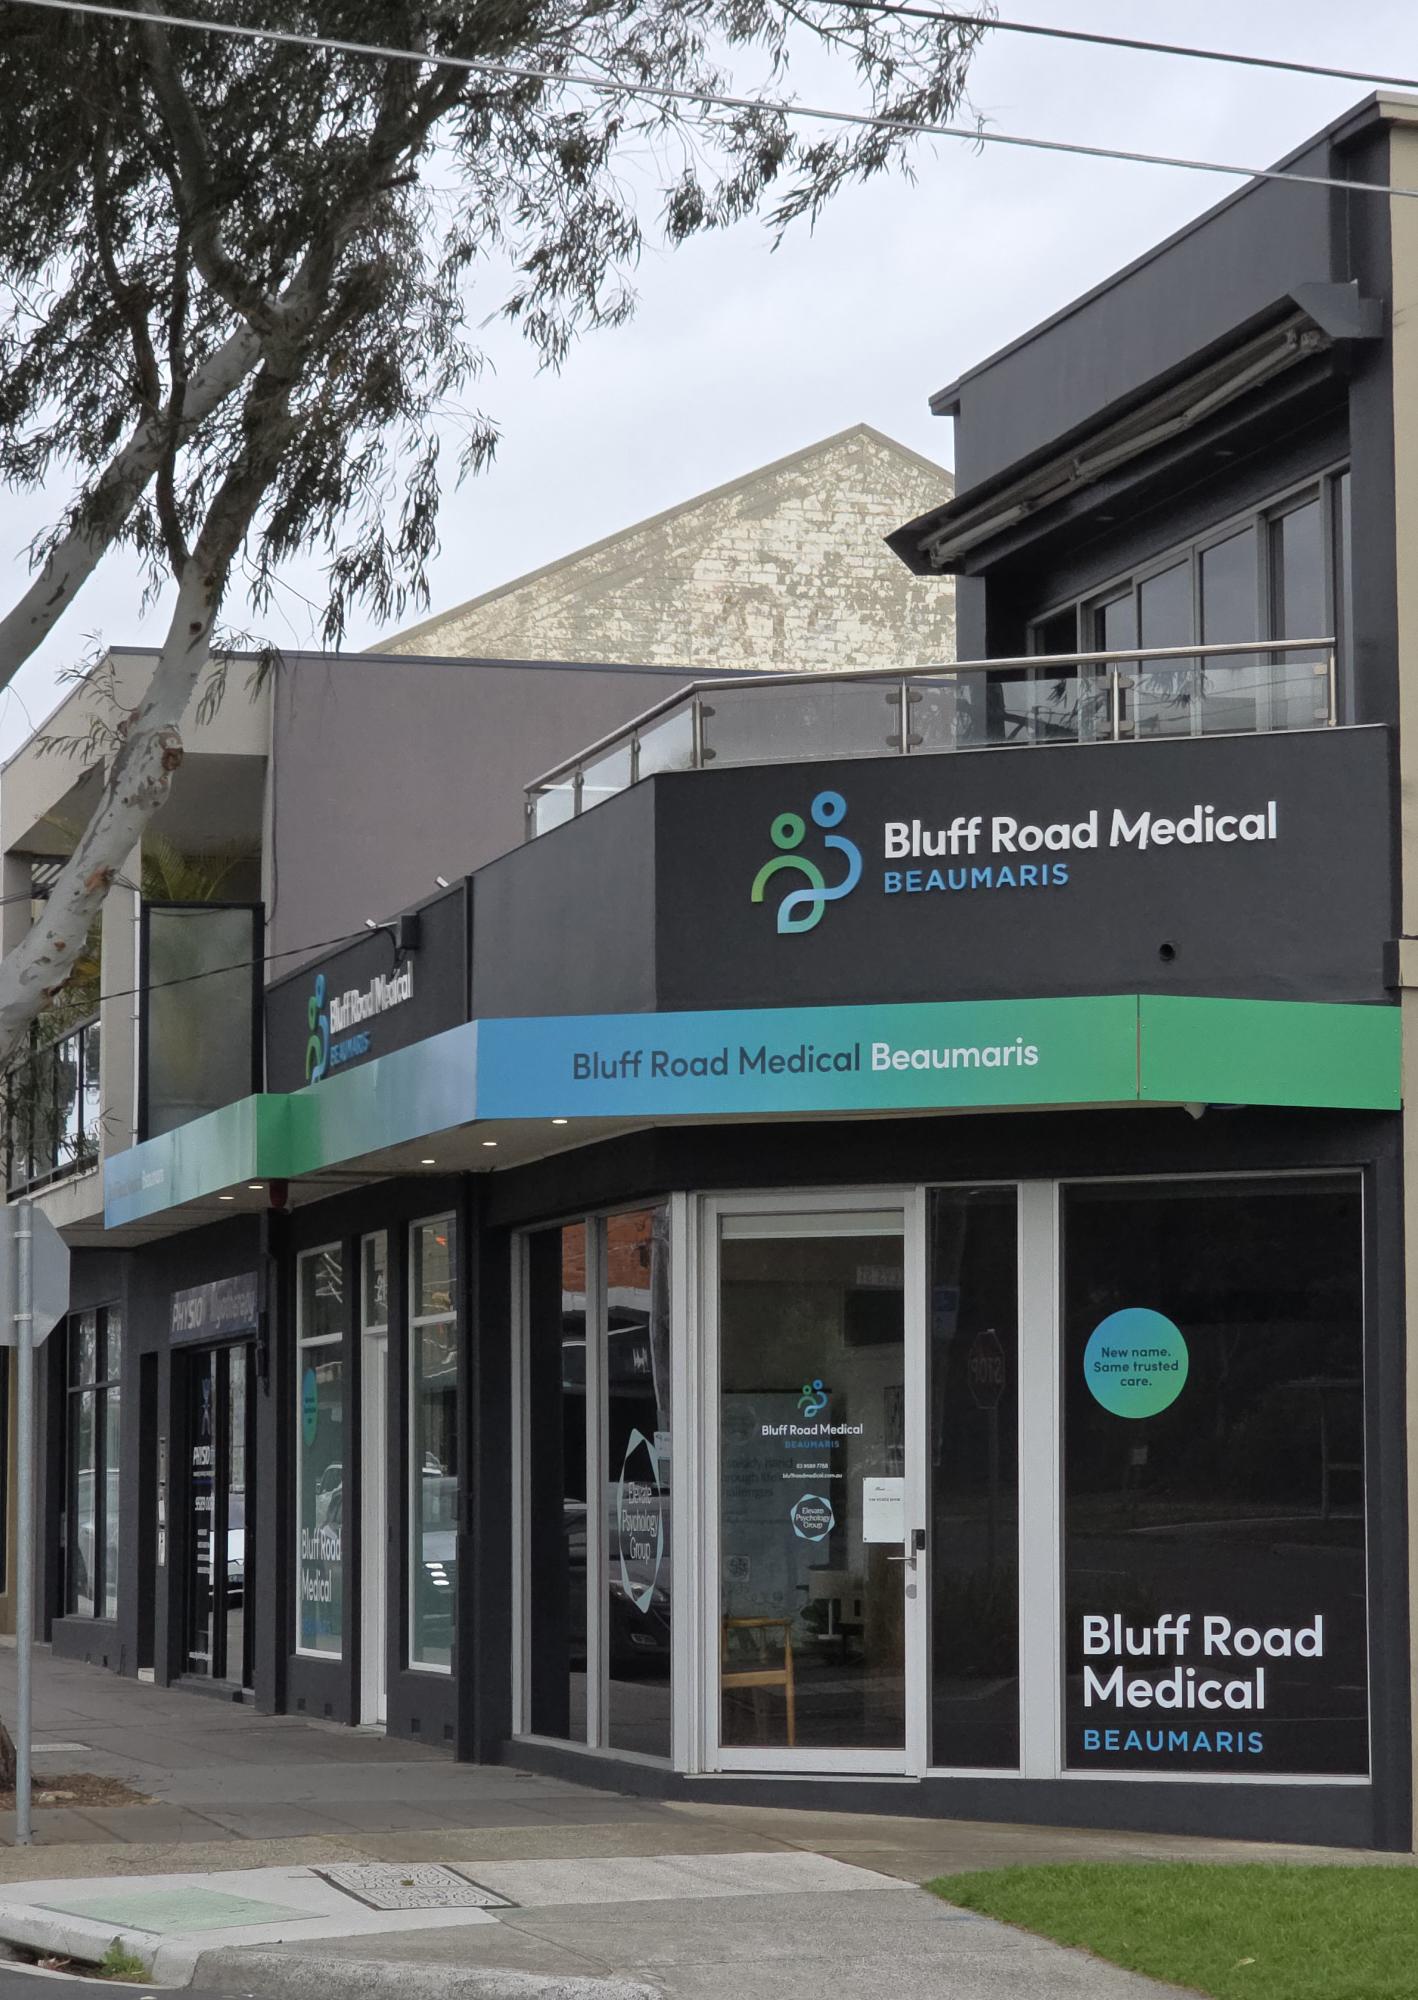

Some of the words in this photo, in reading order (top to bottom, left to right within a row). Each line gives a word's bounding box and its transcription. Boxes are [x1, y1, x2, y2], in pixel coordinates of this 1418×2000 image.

[884, 816, 982, 859] Bluff
[991, 810, 1099, 854] Road
[1109, 801, 1278, 850] Medical
[884, 863, 1070, 894] BEAUMARIS
[573, 1051, 643, 1080] Bluff
[650, 1047, 728, 1078] Road
[739, 1043, 861, 1075] Medical
[871, 1037, 1040, 1072] Beaumaris
[1093, 1361, 1129, 1373] Same
[1133, 1360, 1179, 1371] trusted
[1101, 1347, 1128, 1358] New
[1132, 1348, 1171, 1358] name.
[1120, 1378, 1152, 1387] care.
[762, 1425, 788, 1436] Bluff
[790, 1424, 818, 1435] Road
[820, 1423, 863, 1435] Medical
[622, 1508, 658, 1538] Psychology
[795, 1514, 831, 1523] Psychology
[302, 1528, 320, 1560] Bluff
[630, 1536, 650, 1566] Group
[302, 1568, 332, 1602] Medical
[1083, 1613, 1191, 1655] Bluff
[1203, 1614, 1323, 1657] Road
[1083, 1665, 1265, 1710] Medical
[1083, 1729, 1264, 1753] BEAUMARIS
